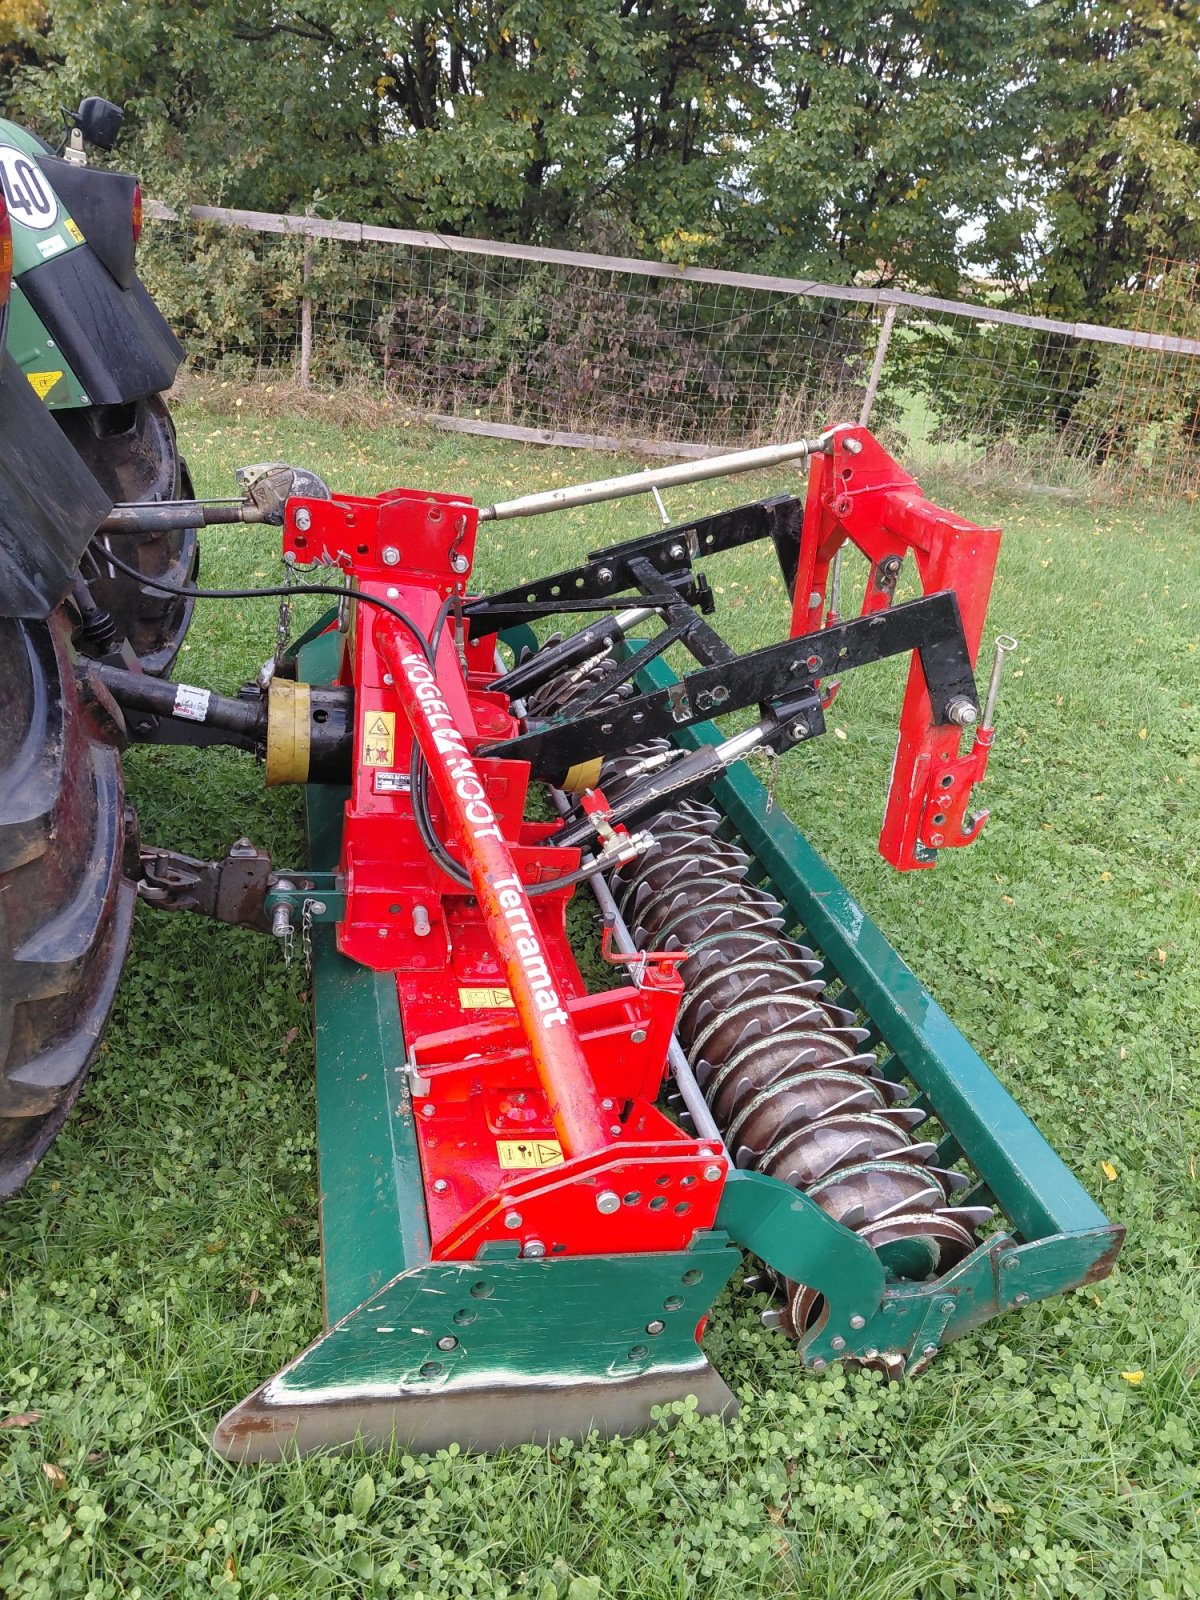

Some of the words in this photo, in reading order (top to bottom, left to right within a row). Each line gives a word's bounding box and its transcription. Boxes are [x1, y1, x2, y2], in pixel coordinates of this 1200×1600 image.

[0, 159, 51, 215] 40
[401, 653, 454, 728] VOGEL
[446, 757, 504, 842] NOOT
[493, 873, 569, 1029] Terramat
